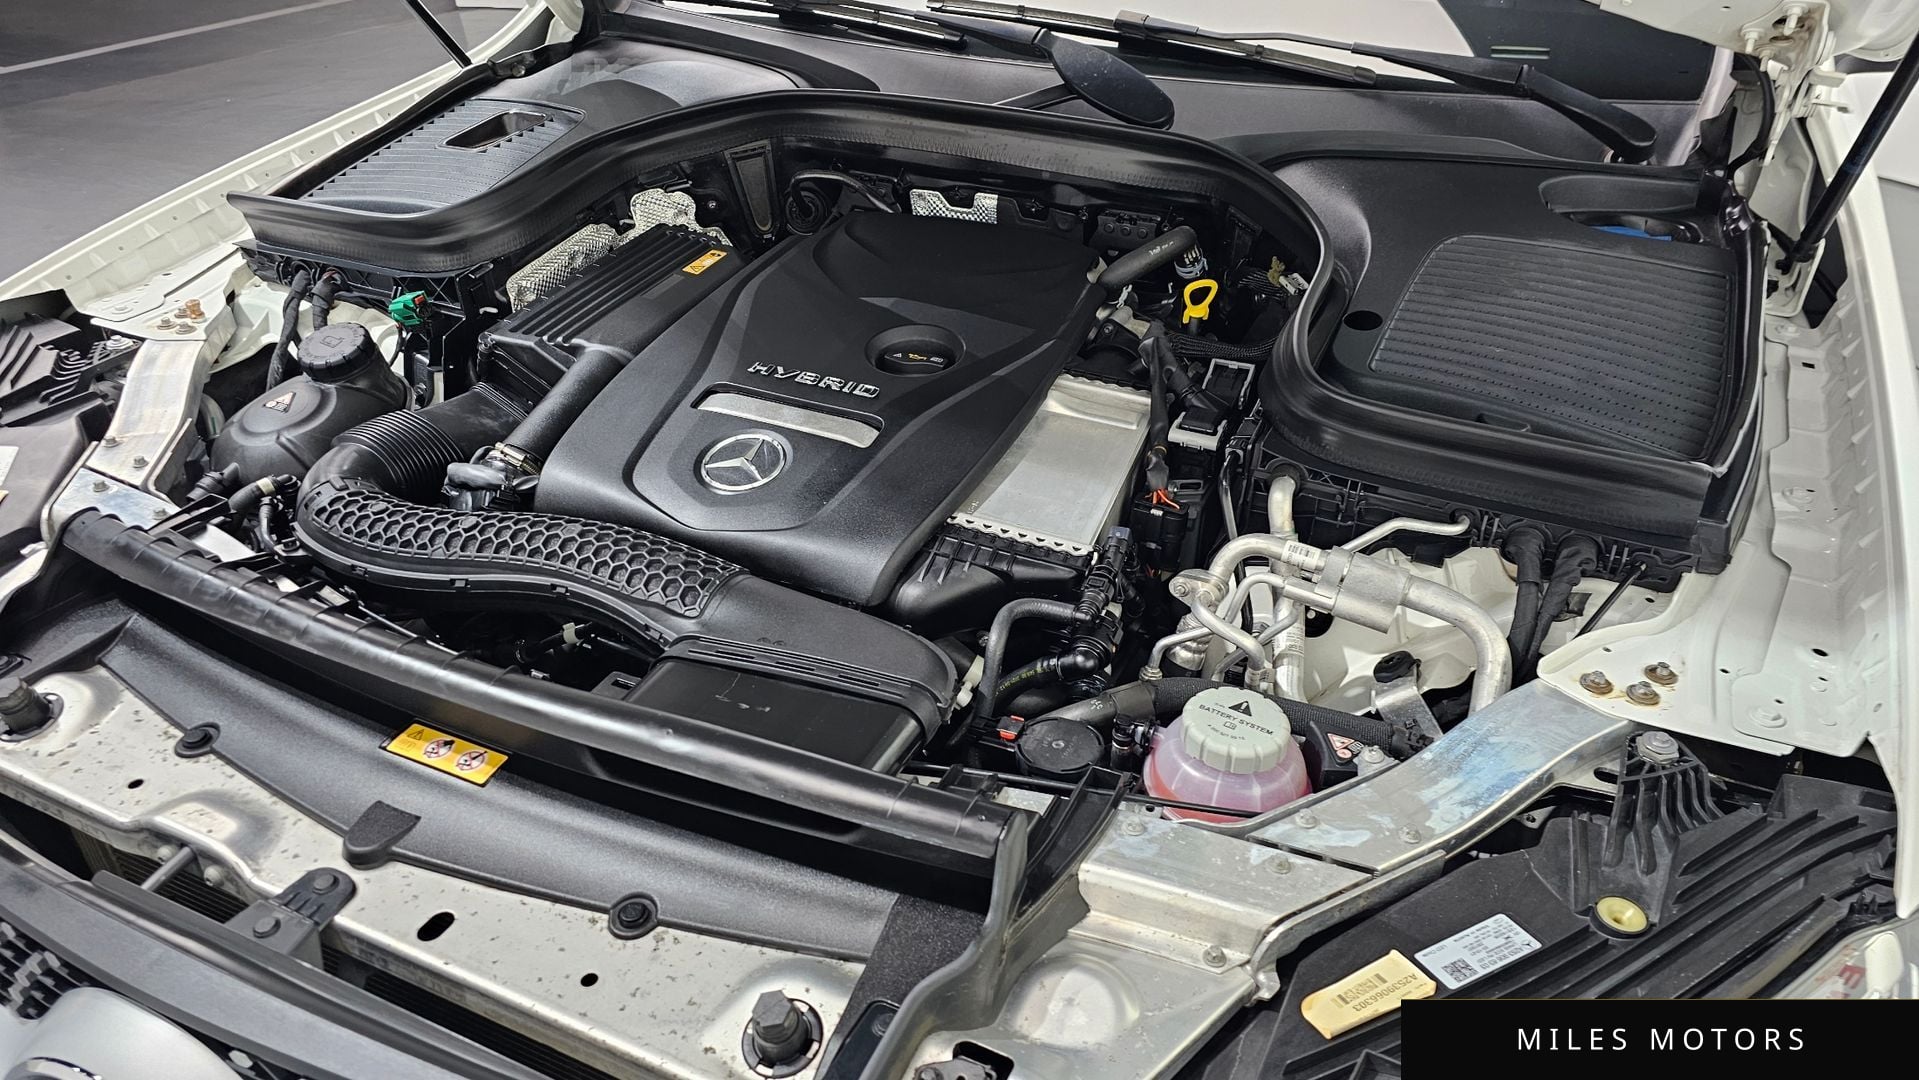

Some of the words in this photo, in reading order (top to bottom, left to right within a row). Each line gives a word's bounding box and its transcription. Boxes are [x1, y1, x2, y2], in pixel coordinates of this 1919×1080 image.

[747, 361, 880, 398] HYBRID
[1199, 704, 1238, 721] BATTERY
[1239, 719, 1274, 735] SYSTEM
[1352, 973, 1418, 1012] A2539066303
